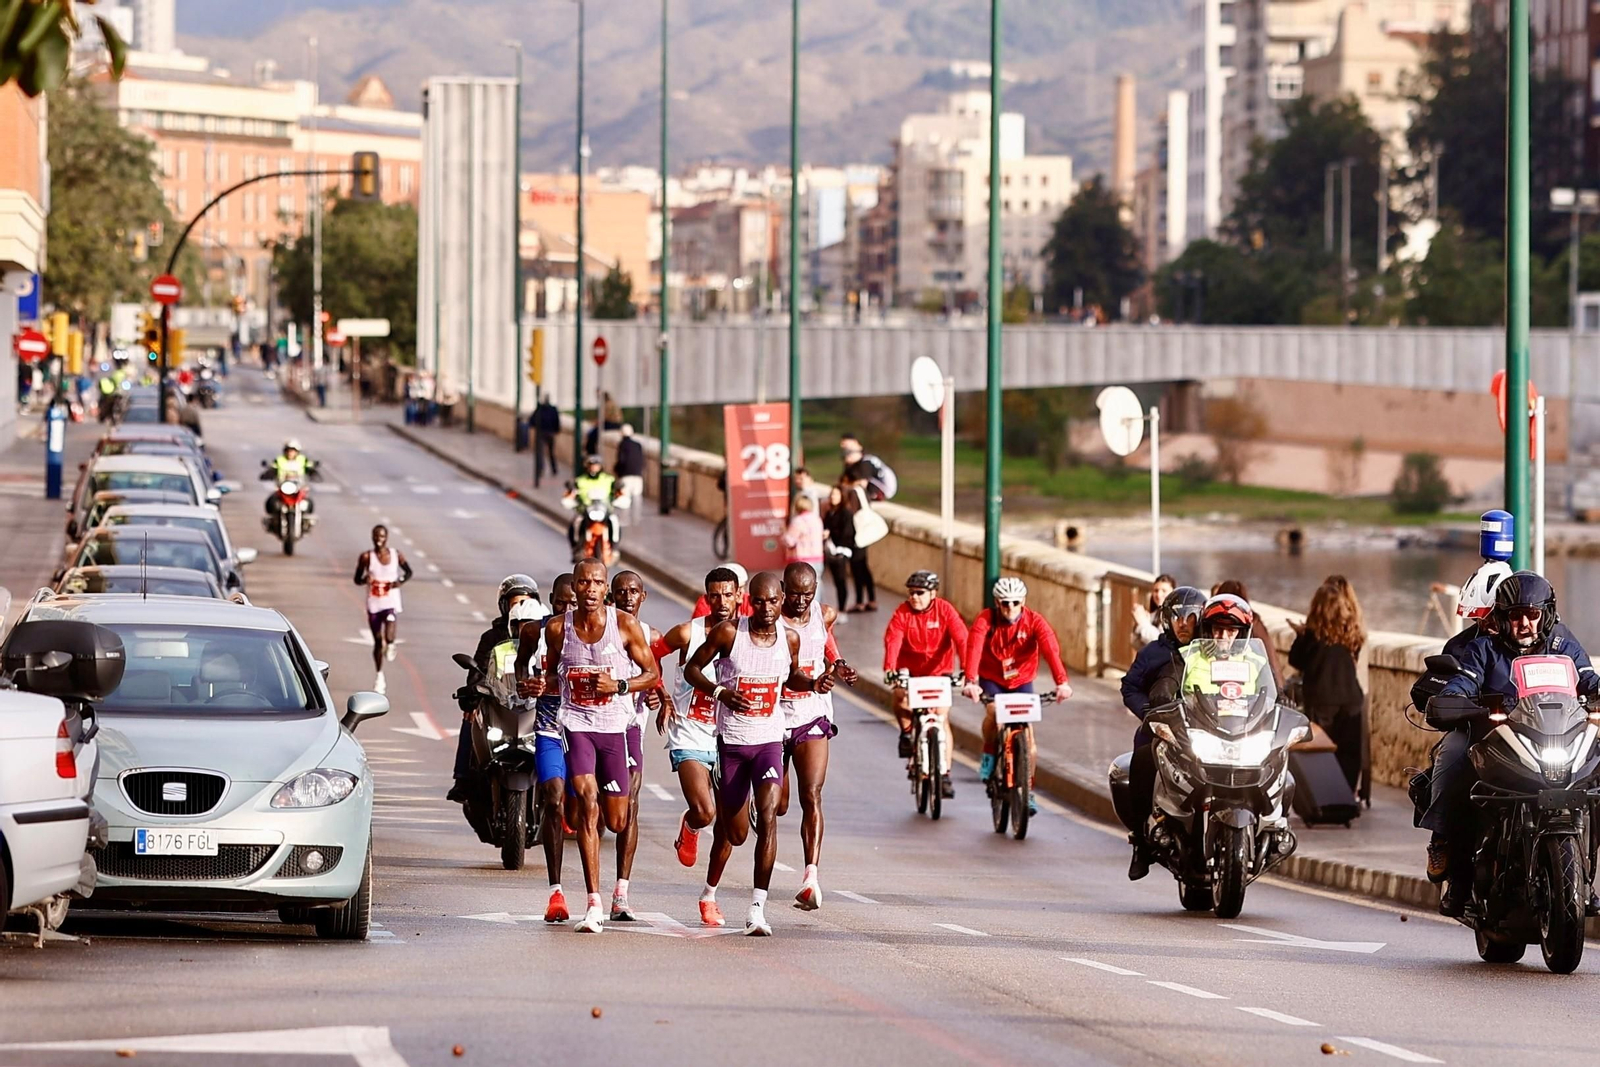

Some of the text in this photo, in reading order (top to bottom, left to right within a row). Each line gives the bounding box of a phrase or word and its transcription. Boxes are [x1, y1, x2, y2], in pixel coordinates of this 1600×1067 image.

[740, 443, 790, 481] 28
[1227, 686, 1238, 698] R
[147, 834, 183, 850] 8176
[188, 834, 215, 850] FGL
